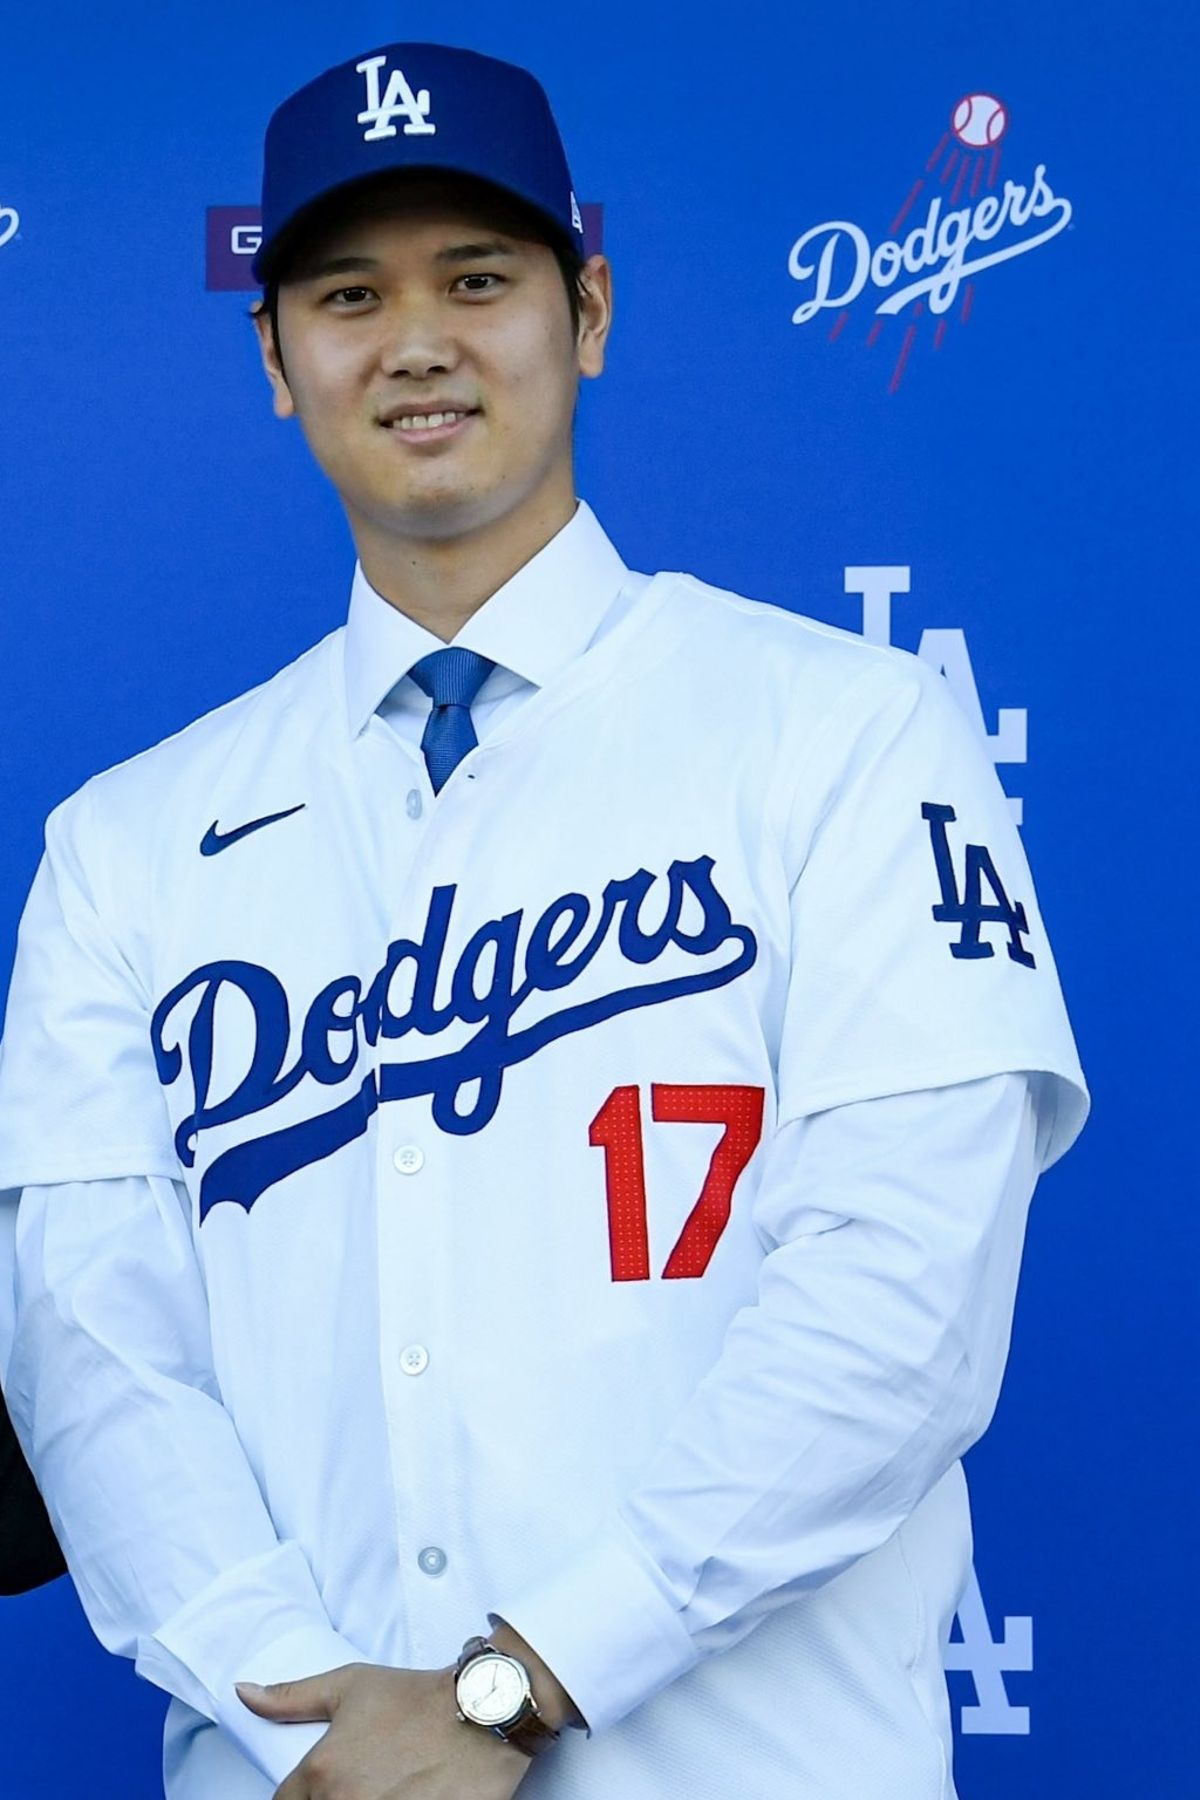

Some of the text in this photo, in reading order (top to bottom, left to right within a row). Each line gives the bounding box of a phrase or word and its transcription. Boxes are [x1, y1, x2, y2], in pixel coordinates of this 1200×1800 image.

[356, 55, 436, 141] LA
[788, 164, 1072, 324] Dodgers
[921, 801, 1036, 970] LA
[150, 854, 758, 1228] Dodgers
[588, 1082, 765, 1282] 17
